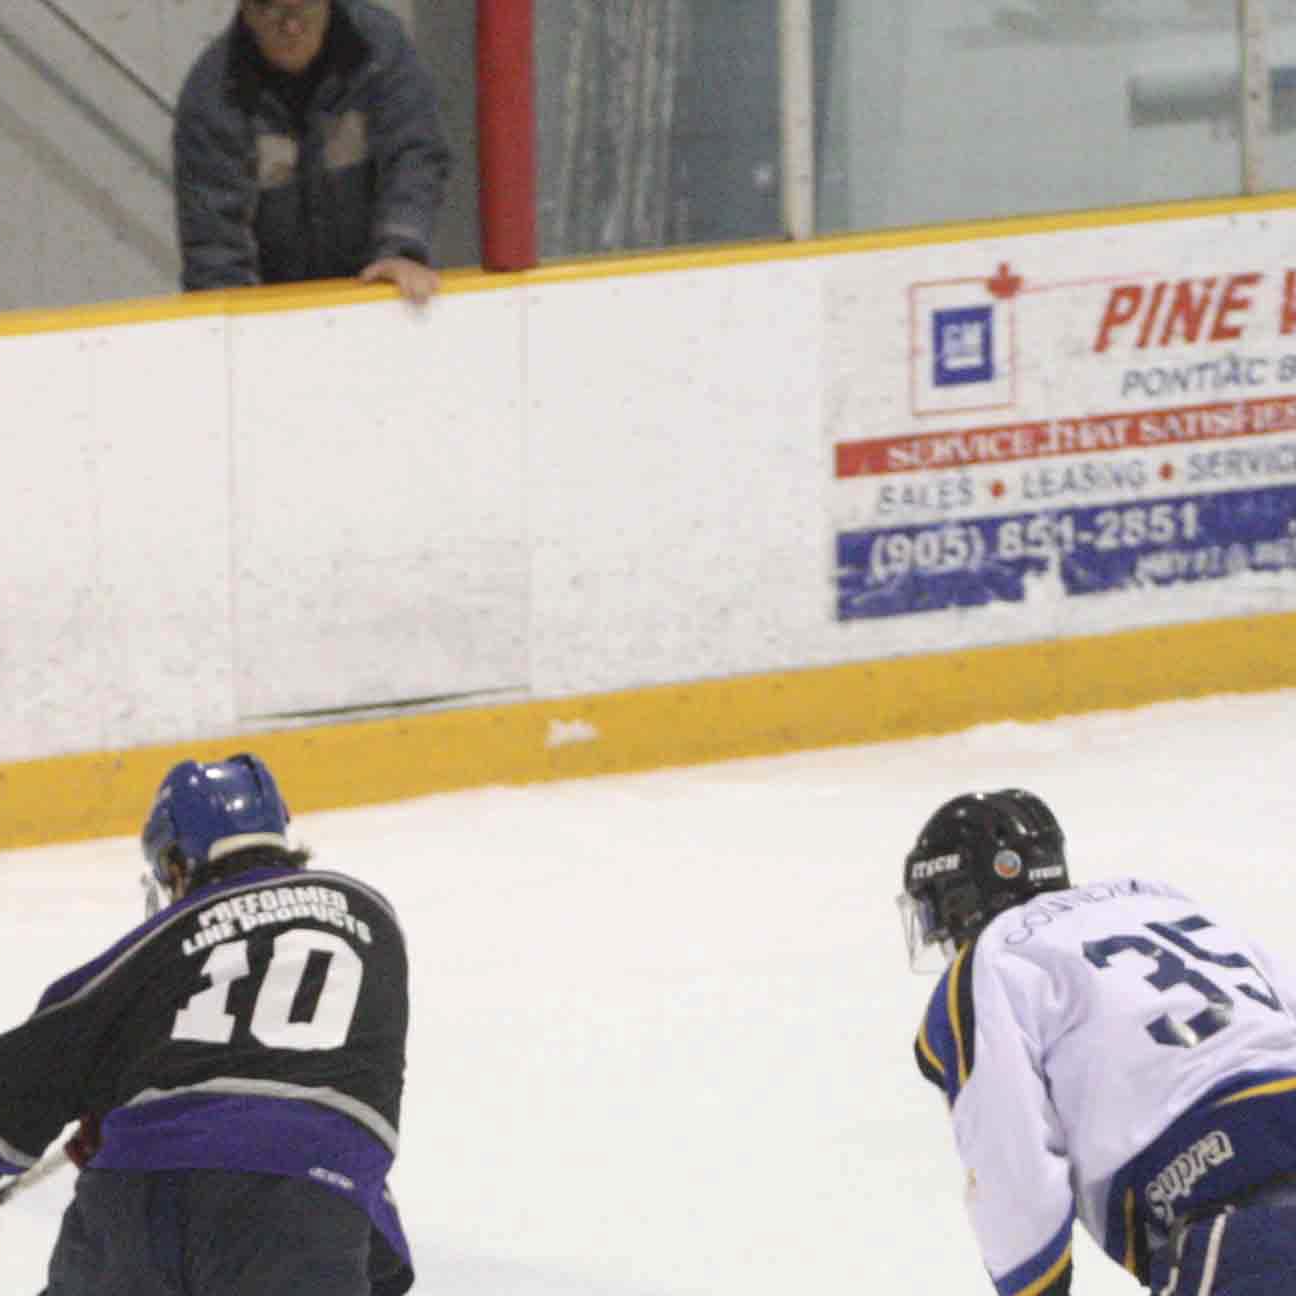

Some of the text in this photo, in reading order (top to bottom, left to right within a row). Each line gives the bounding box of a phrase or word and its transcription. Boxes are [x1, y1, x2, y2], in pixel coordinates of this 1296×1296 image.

[1094, 273, 1263, 353] PINE
[1121, 354, 1274, 398] PONTIAC
[887, 428, 1032, 470] SERVICE
[878, 478, 975, 514] SALES
[1021, 460, 1147, 501] LEASING
[868, 526, 984, 582] (905)
[181, 903, 372, 956] LINE PRODUCTS
[198, 885, 348, 928] PREFORMED
[170, 927, 364, 1052] 10
[1082, 914, 1283, 1049] 35
